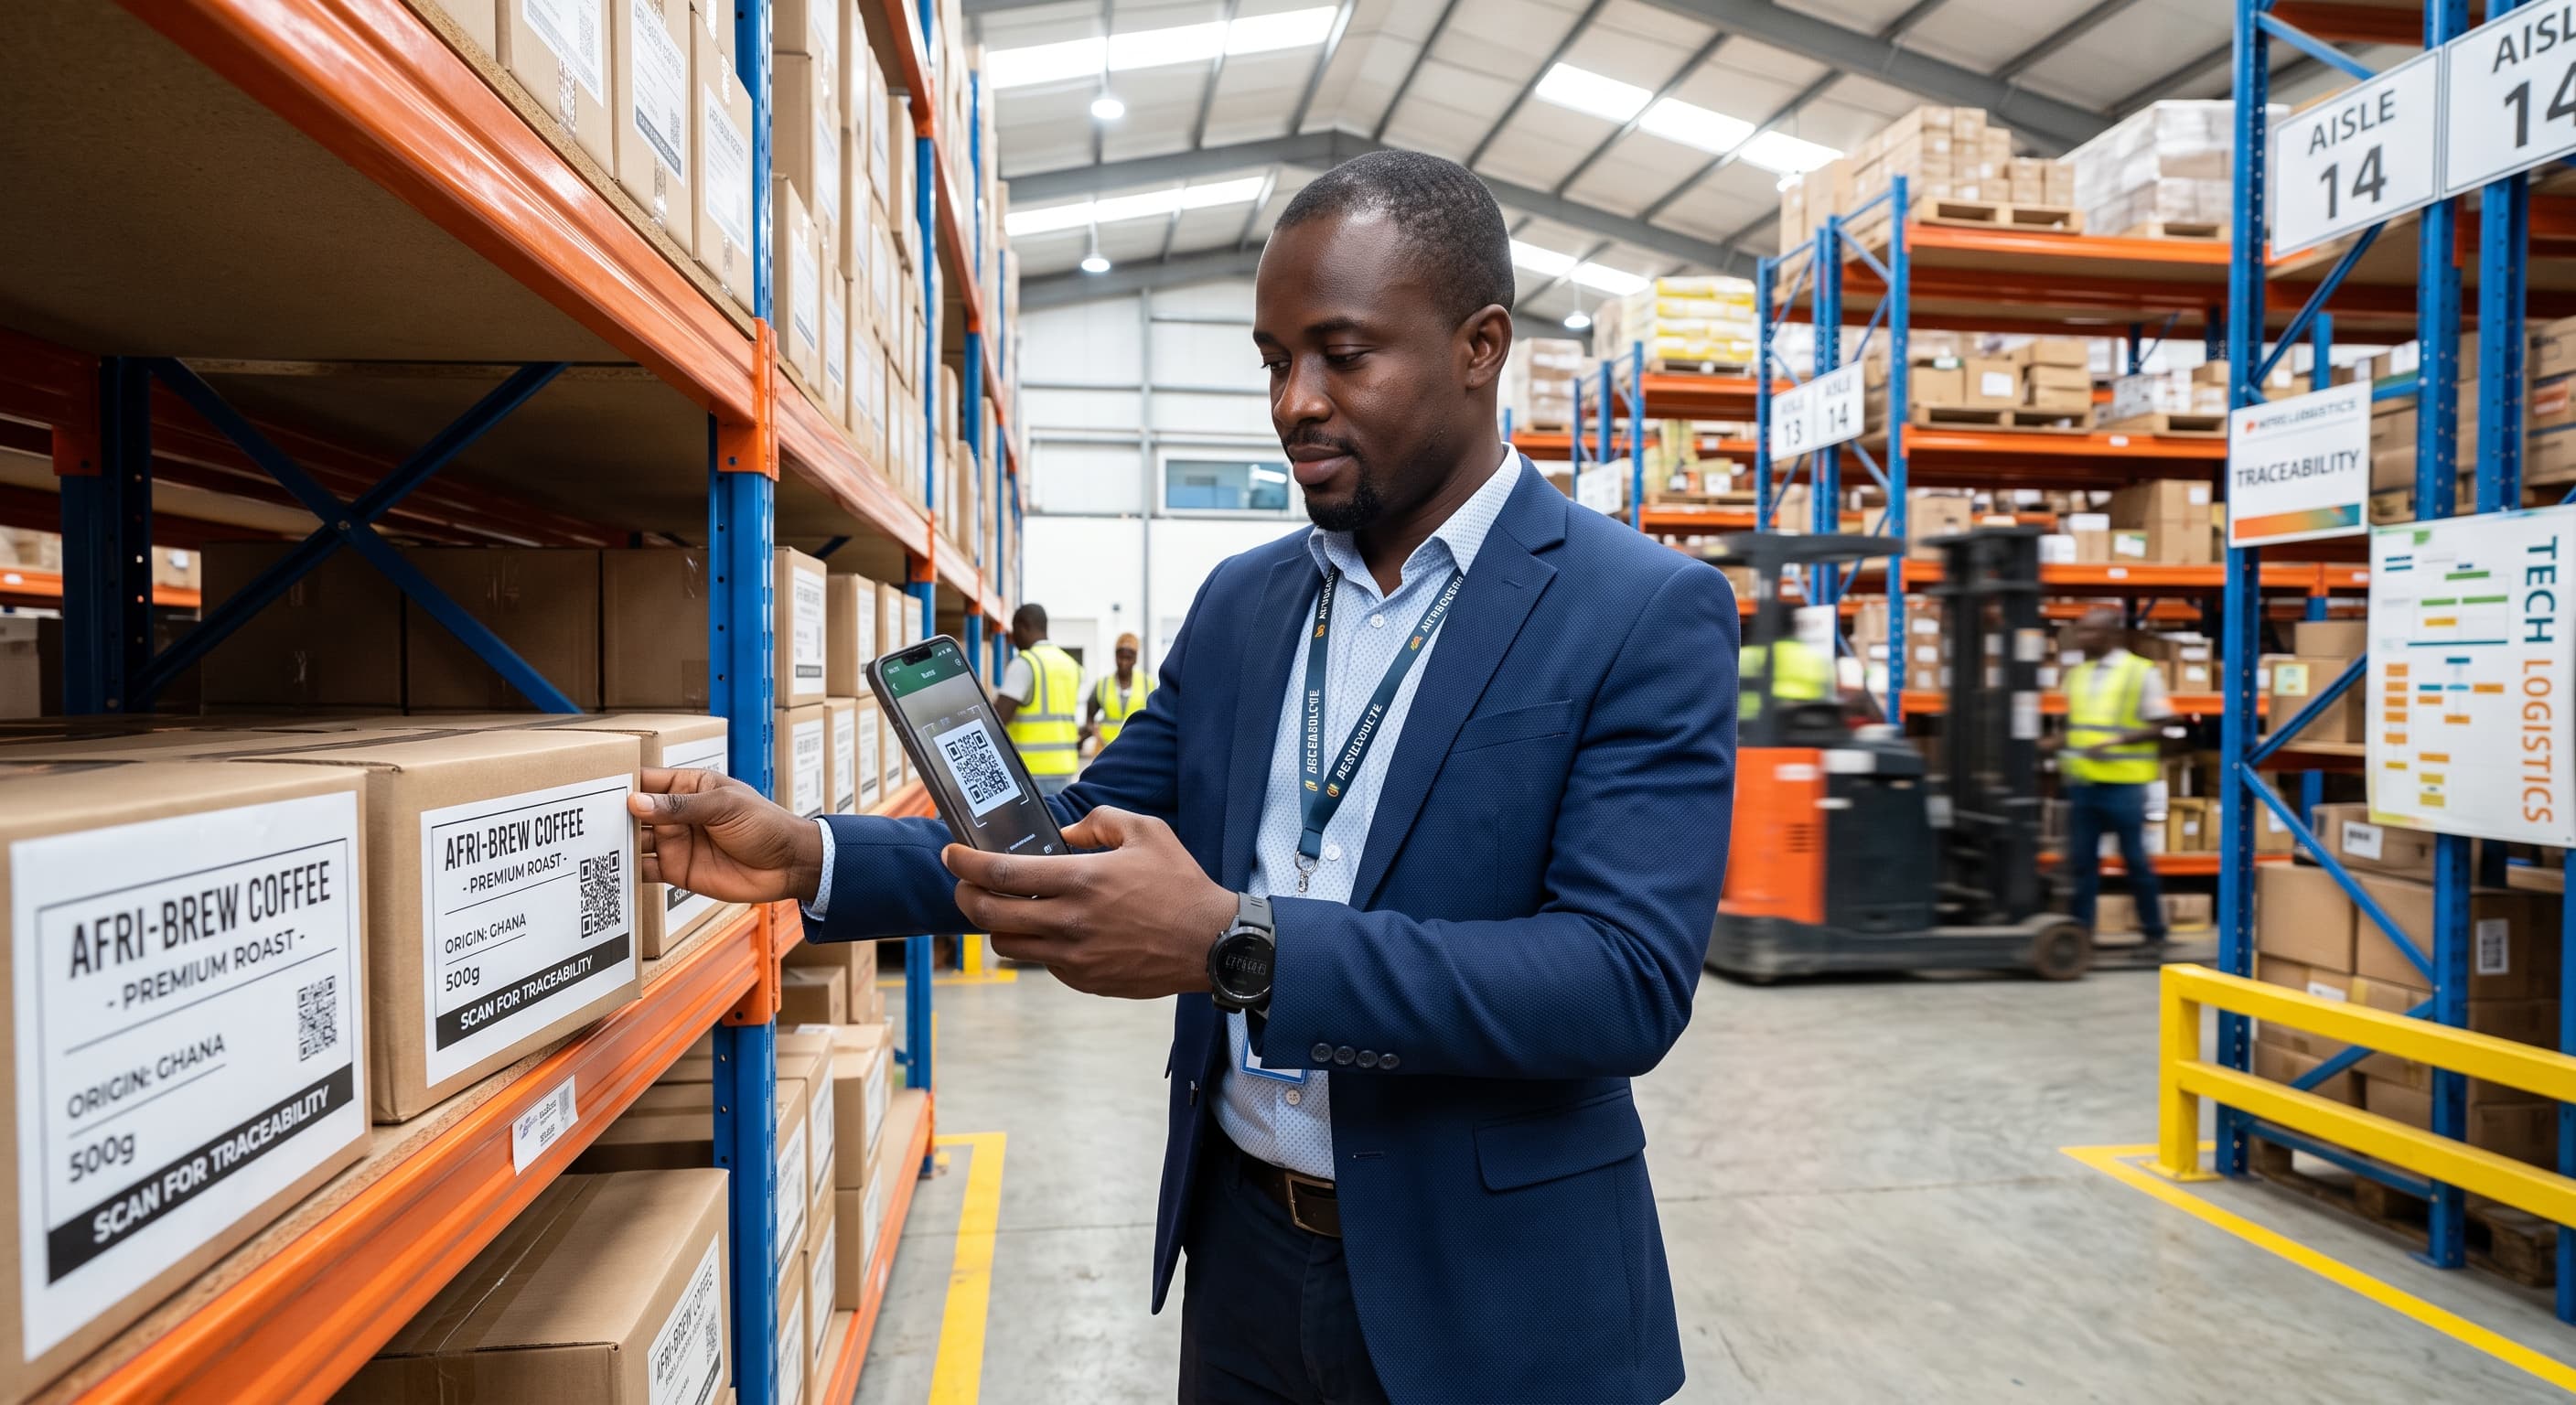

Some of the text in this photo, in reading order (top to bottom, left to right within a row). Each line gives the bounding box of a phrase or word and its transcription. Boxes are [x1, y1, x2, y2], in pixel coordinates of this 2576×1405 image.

[2308, 89, 2395, 156] AISLE
[2321, 144, 2387, 220] 14
[1785, 419, 1801, 447] 13
[1829, 402, 1848, 433] 14
[2236, 448, 2360, 488] TRACEABILITY
[2522, 535, 2558, 823] TECH LOGISTICS
[445, 808, 585, 871] AFRI-BREW COFFEE
[470, 863, 524, 893] PREMIUM
[528, 853, 562, 876] ROAST
[70, 860, 331, 980] AFRI-BREW COFFEE
[445, 913, 526, 954] ORIGIN: GHANA
[123, 951, 228, 1010] PREMIUM
[234, 928, 295, 970] ROAST
[445, 965, 480, 992] 500g
[460, 955, 593, 1030] SCAN FOR TRACEABILITY
[67, 1033, 225, 1120] ORIGIN: GHANA
[69, 1133, 135, 1184] 500g
[93, 1085, 330, 1243] SCAN FOR TRACEABILITY
